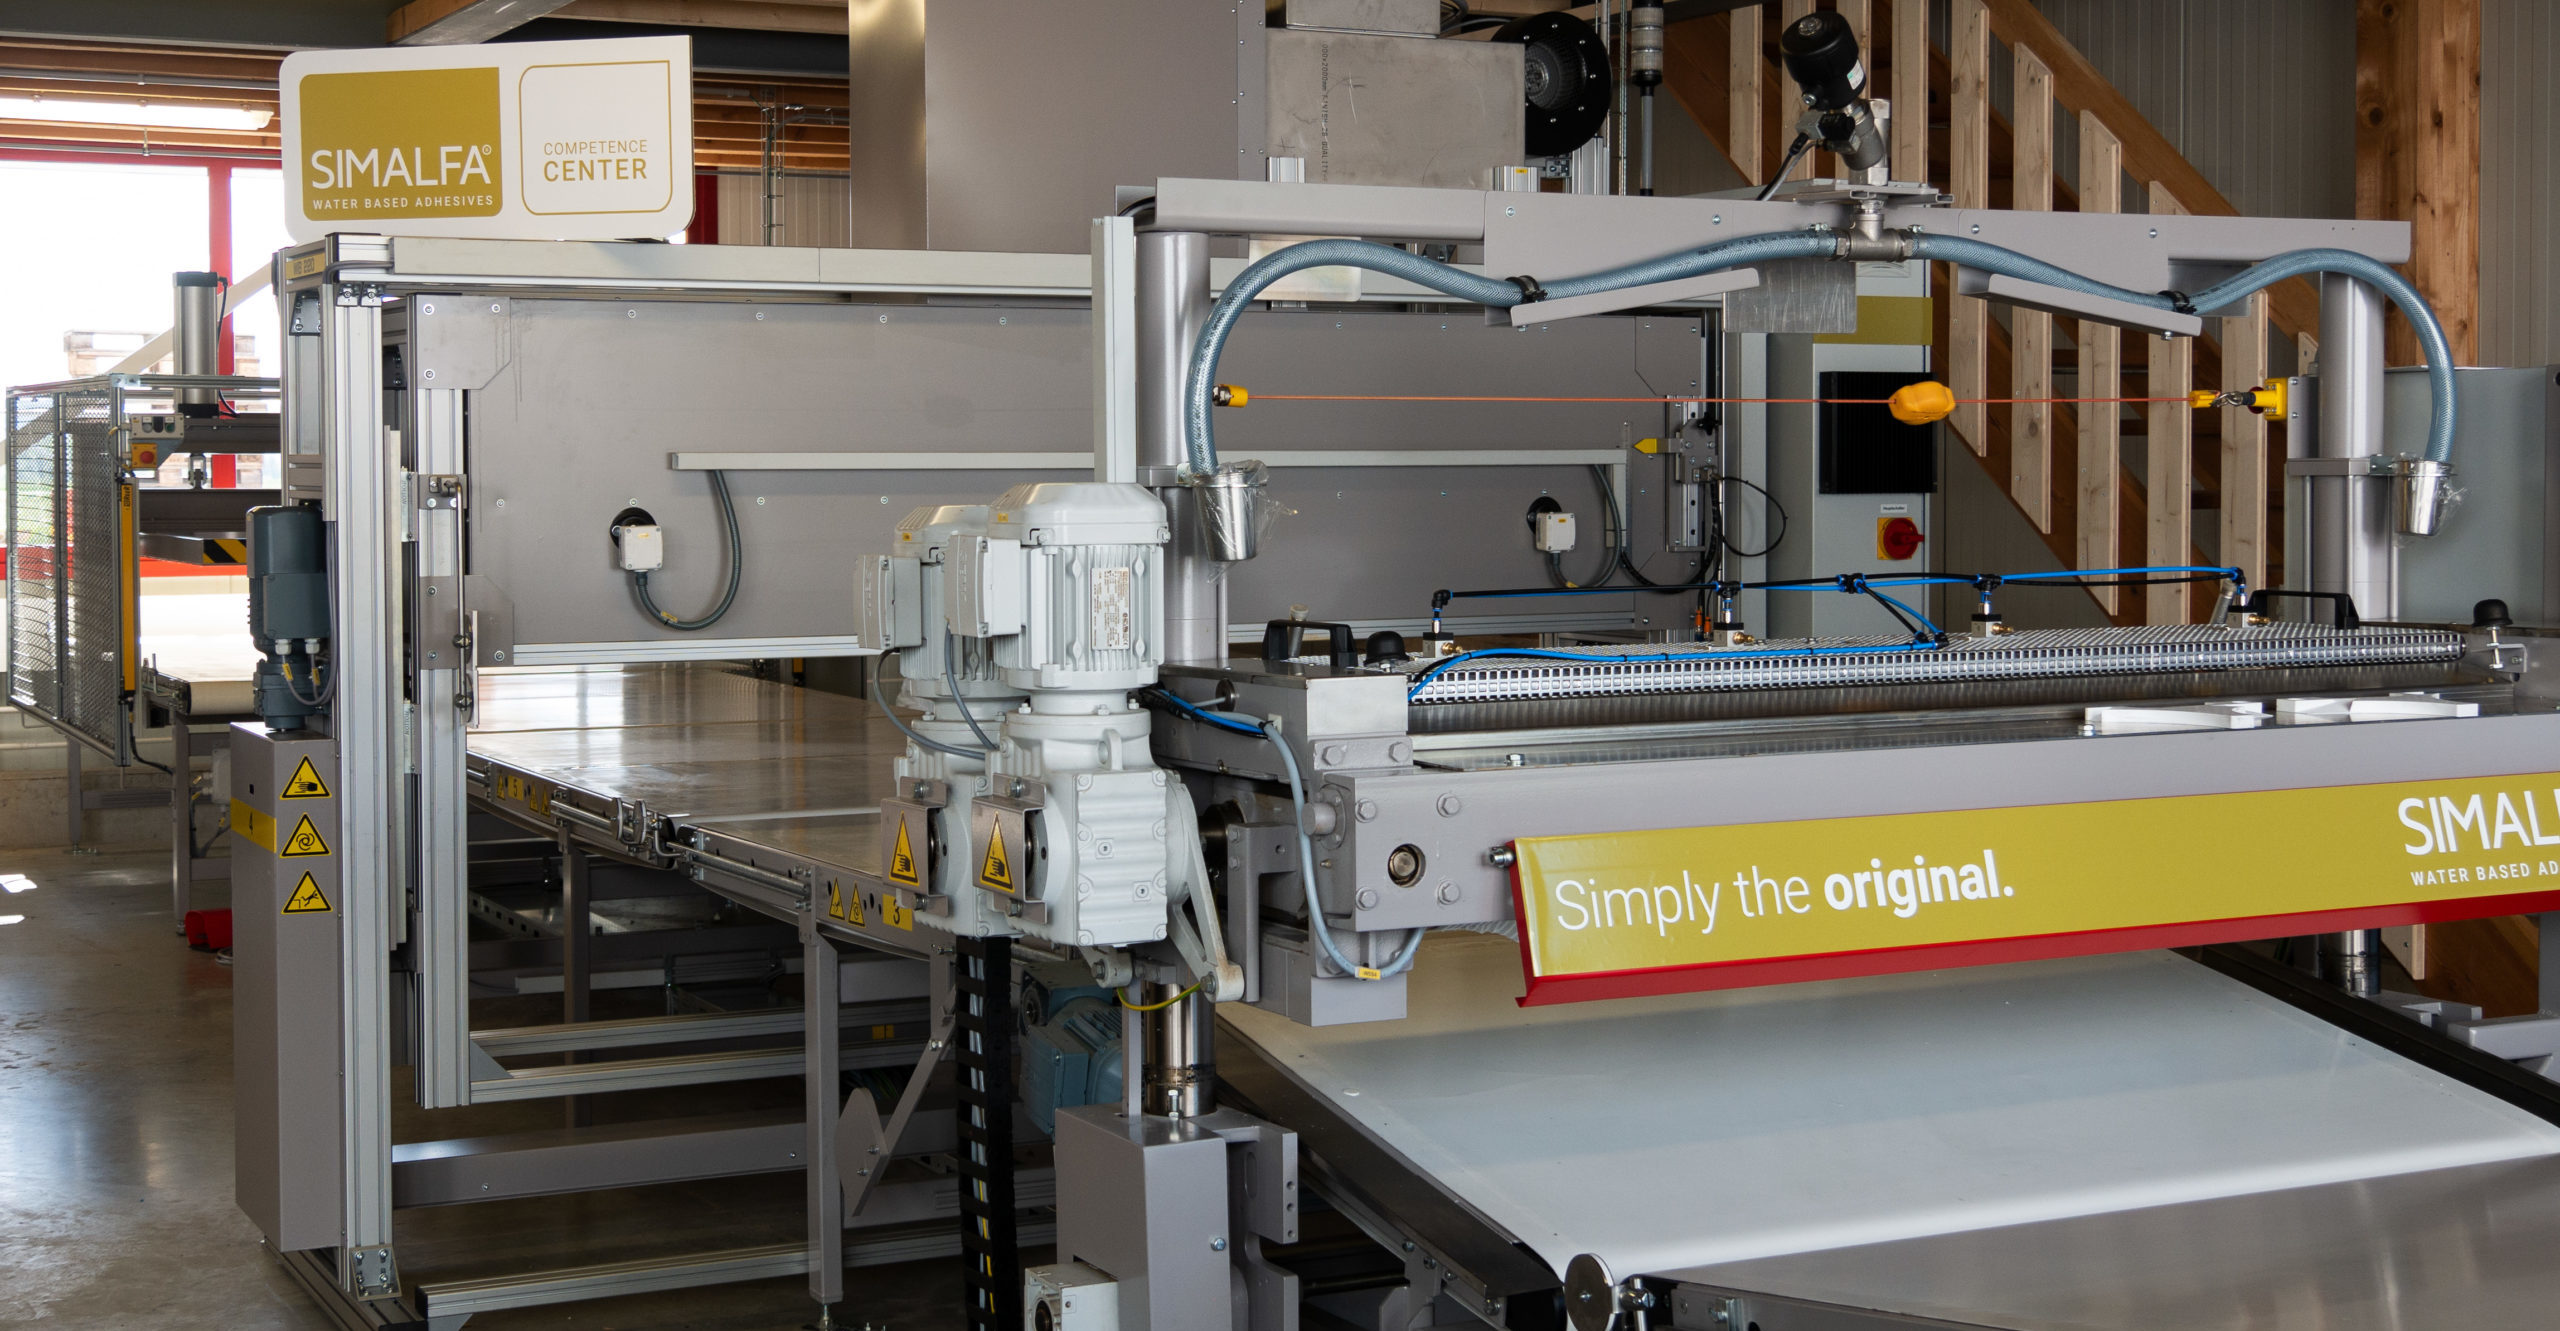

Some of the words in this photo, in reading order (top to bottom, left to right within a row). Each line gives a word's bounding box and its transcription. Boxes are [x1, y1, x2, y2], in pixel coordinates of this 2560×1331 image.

[543, 139, 648, 156] COMPETENCE
[543, 158, 648, 182] CENTER
[312, 199, 358, 210] WATER
[364, 197, 409, 209] BASED
[415, 195, 493, 208] ADHESIVES
[513, 778, 518, 798] 5
[2397, 788, 2560, 856] SIMAL
[2410, 867, 2470, 886] WATER
[2475, 862, 2530, 881] BASED
[1555, 869, 1720, 937] Simply
[1733, 865, 1811, 917] the
[1823, 848, 2015, 918] original.
[893, 898, 901, 925] 3
